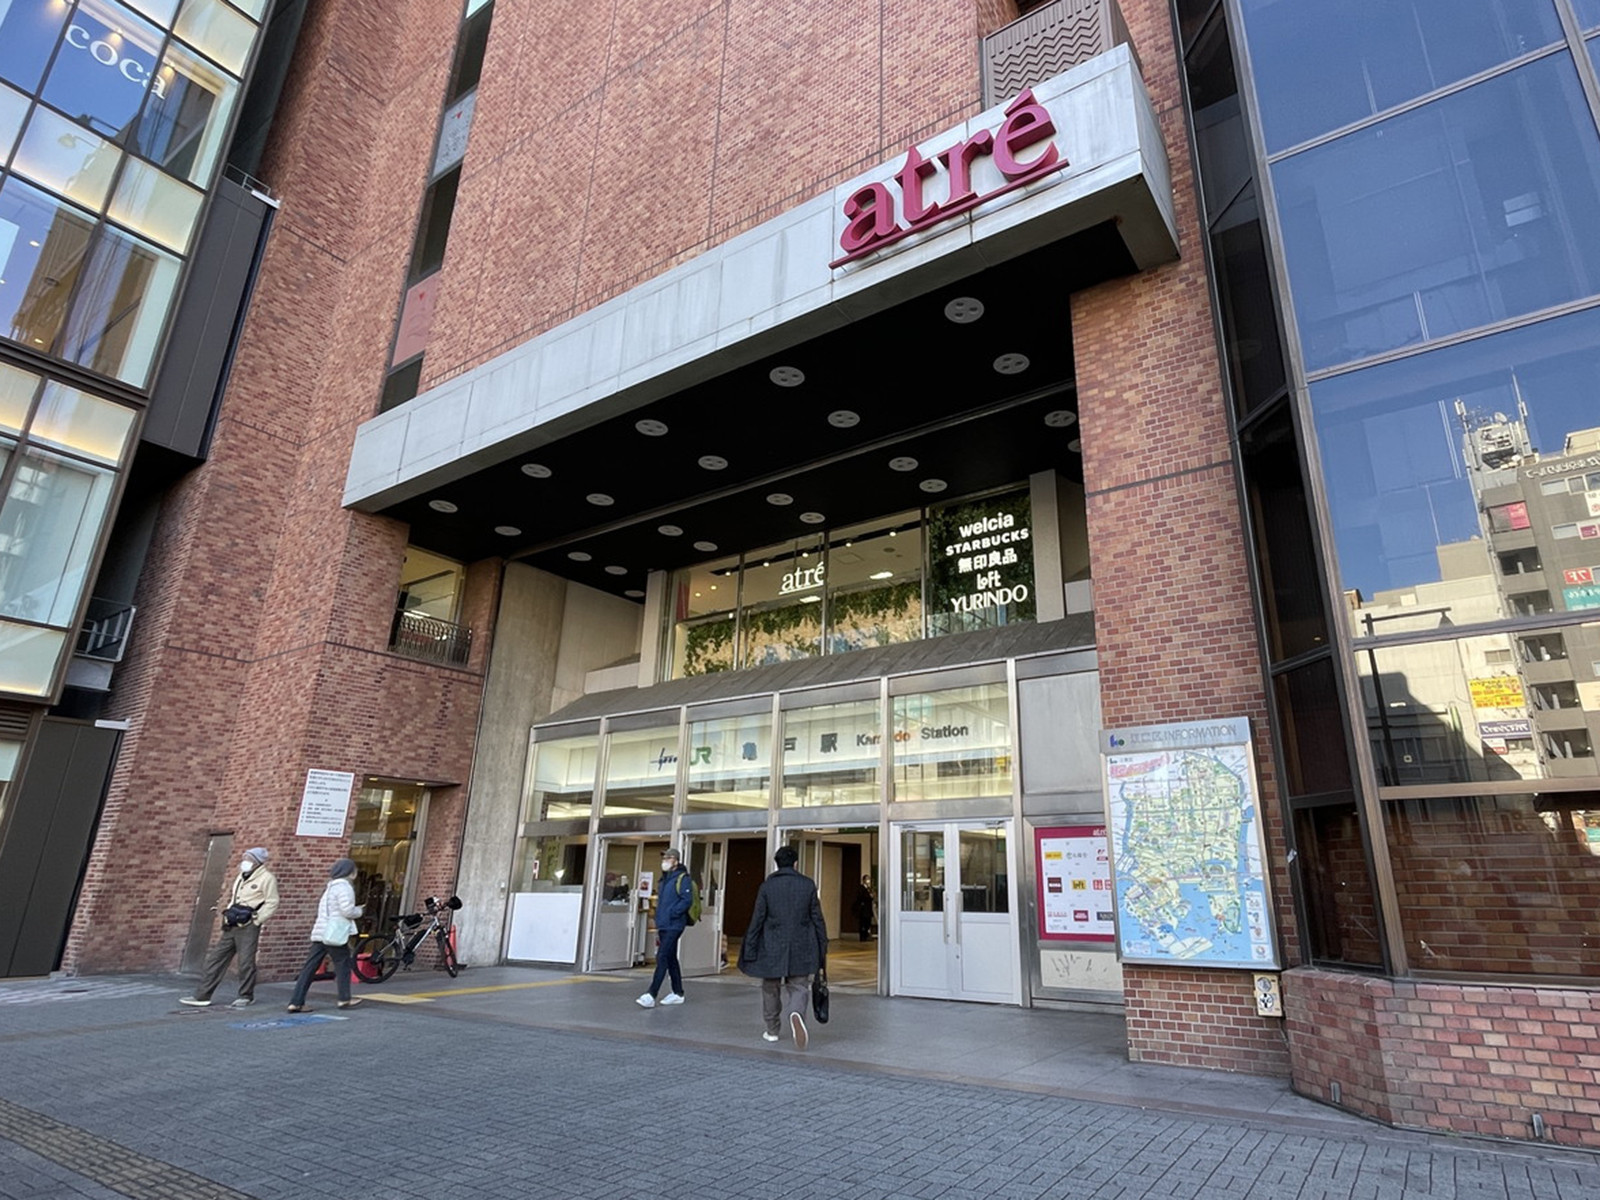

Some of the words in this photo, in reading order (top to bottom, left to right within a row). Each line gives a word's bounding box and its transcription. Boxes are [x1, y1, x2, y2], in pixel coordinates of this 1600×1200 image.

[65, 24, 166, 100] coca
[838, 87, 1061, 259] atré
[959, 512, 1014, 538] welcia
[945, 528, 1029, 556] STARBUCKS
[957, 547, 1018, 574] 無印良品
[781, 561, 825, 593] atré
[950, 584, 1028, 613] YURINDO
[689, 746, 712, 766] JR
[921, 724, 968, 740] Station
[1164, 724, 1237, 741] INFORMATION
